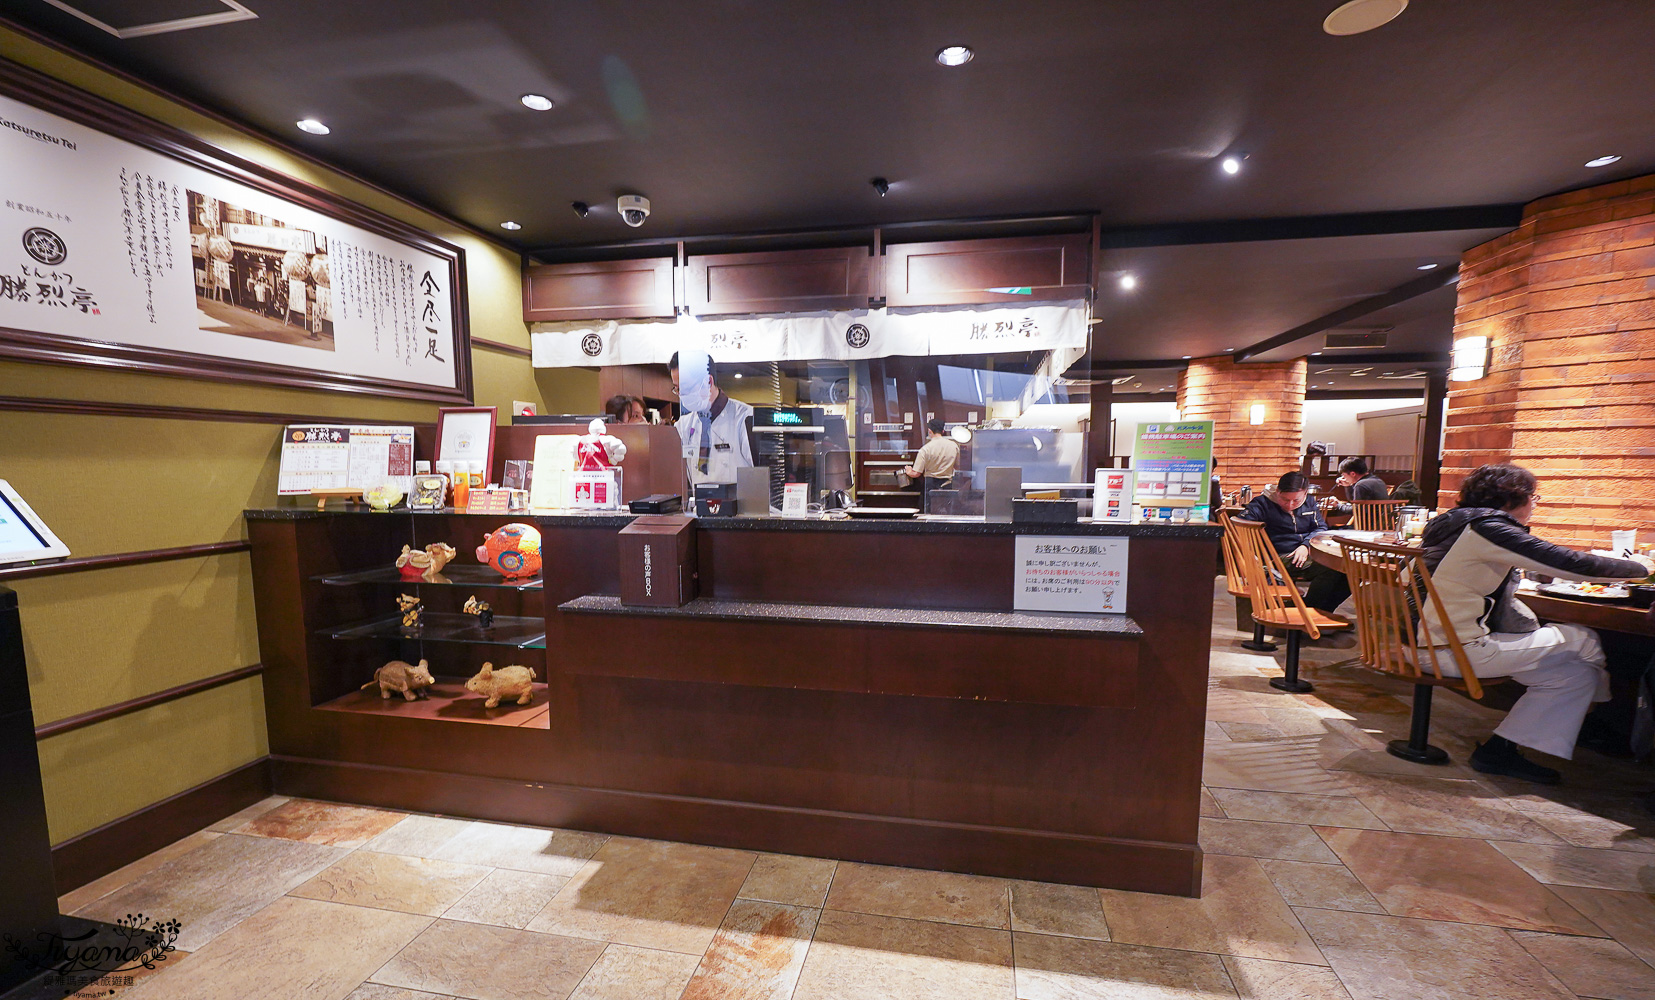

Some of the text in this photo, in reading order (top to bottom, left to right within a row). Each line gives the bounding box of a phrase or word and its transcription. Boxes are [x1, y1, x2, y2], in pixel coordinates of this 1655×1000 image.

[61, 138, 77, 151] Tei
[21, 264, 73, 286] とんかつ
[0, 275, 98, 313] 勝烈亭
[970, 317, 1038, 340] 勝烈亭
[1035, 544, 1106, 554] お客様へのお願い
[1025, 569, 1120, 577] お待ちのお客様がいらっしゃる場合
[1025, 586, 1082, 594] お願い申し上げます。
